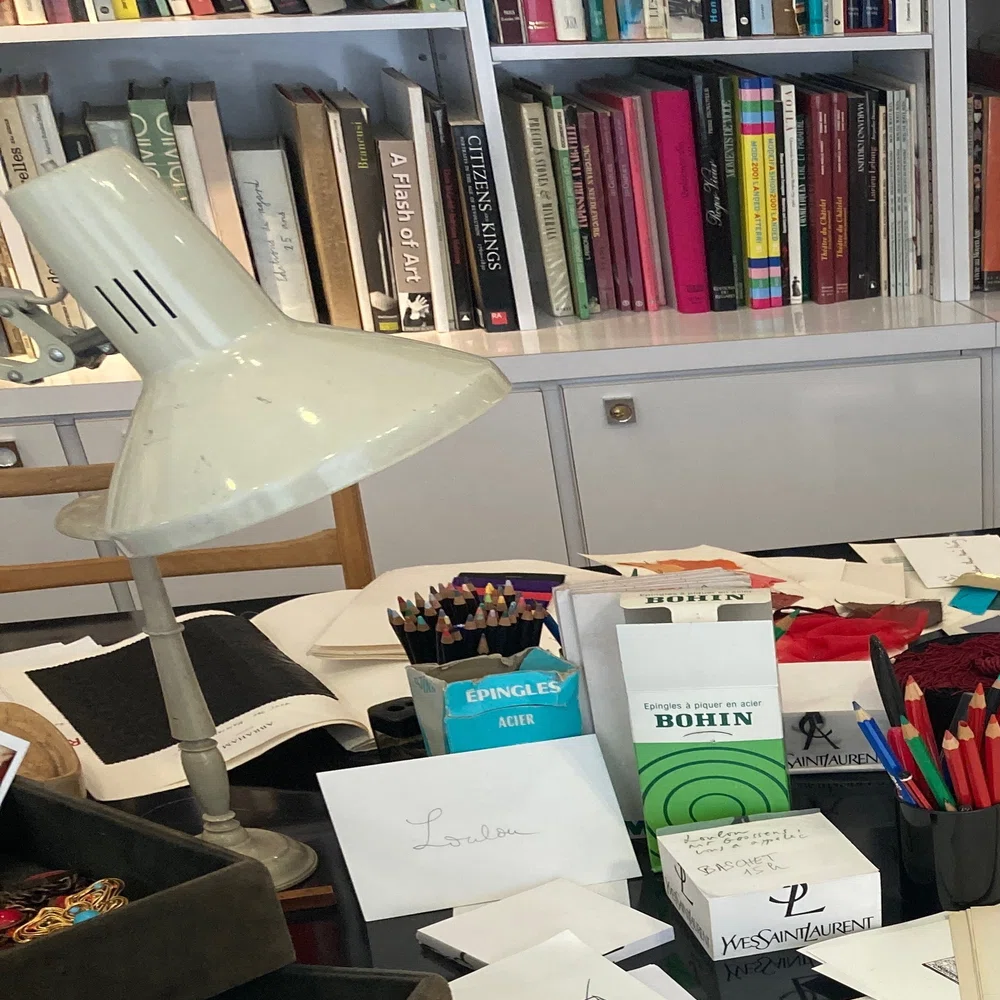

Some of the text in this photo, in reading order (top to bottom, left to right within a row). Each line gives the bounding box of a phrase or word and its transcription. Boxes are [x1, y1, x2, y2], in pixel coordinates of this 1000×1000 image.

[856, 103, 865, 139] MARIANO
[353, 121, 369, 169] Brancusi
[720, 99, 736, 178] MOMENTS DE MODE
[750, 141, 758, 162] MODE
[528, 117, 557, 240] PRECIOUS STONES & MINERALS
[467, 135, 502, 272] CITIZENS KINGS
[583, 144, 601, 239] VICTORIAN NEEDLEWORK
[390, 152, 422, 284] A Flash of Art
[836, 224, 842, 233] du
[821, 226, 827, 236] du
[820, 236, 828, 260] Théâtre
[645, 594, 746, 604] BOHIN
[466, 681, 562, 703] ÉPINGLES
[643, 702, 682, 712] Epingles
[685, 701, 692, 709] à
[694, 701, 723, 712] piquer
[740, 699, 762, 708] acier
[498, 714, 535, 728] ACIER
[655, 712, 753, 728] BOHIN
[222, 721, 273, 749] ABRAHAM
[697, 852, 779, 876] BASCHET
